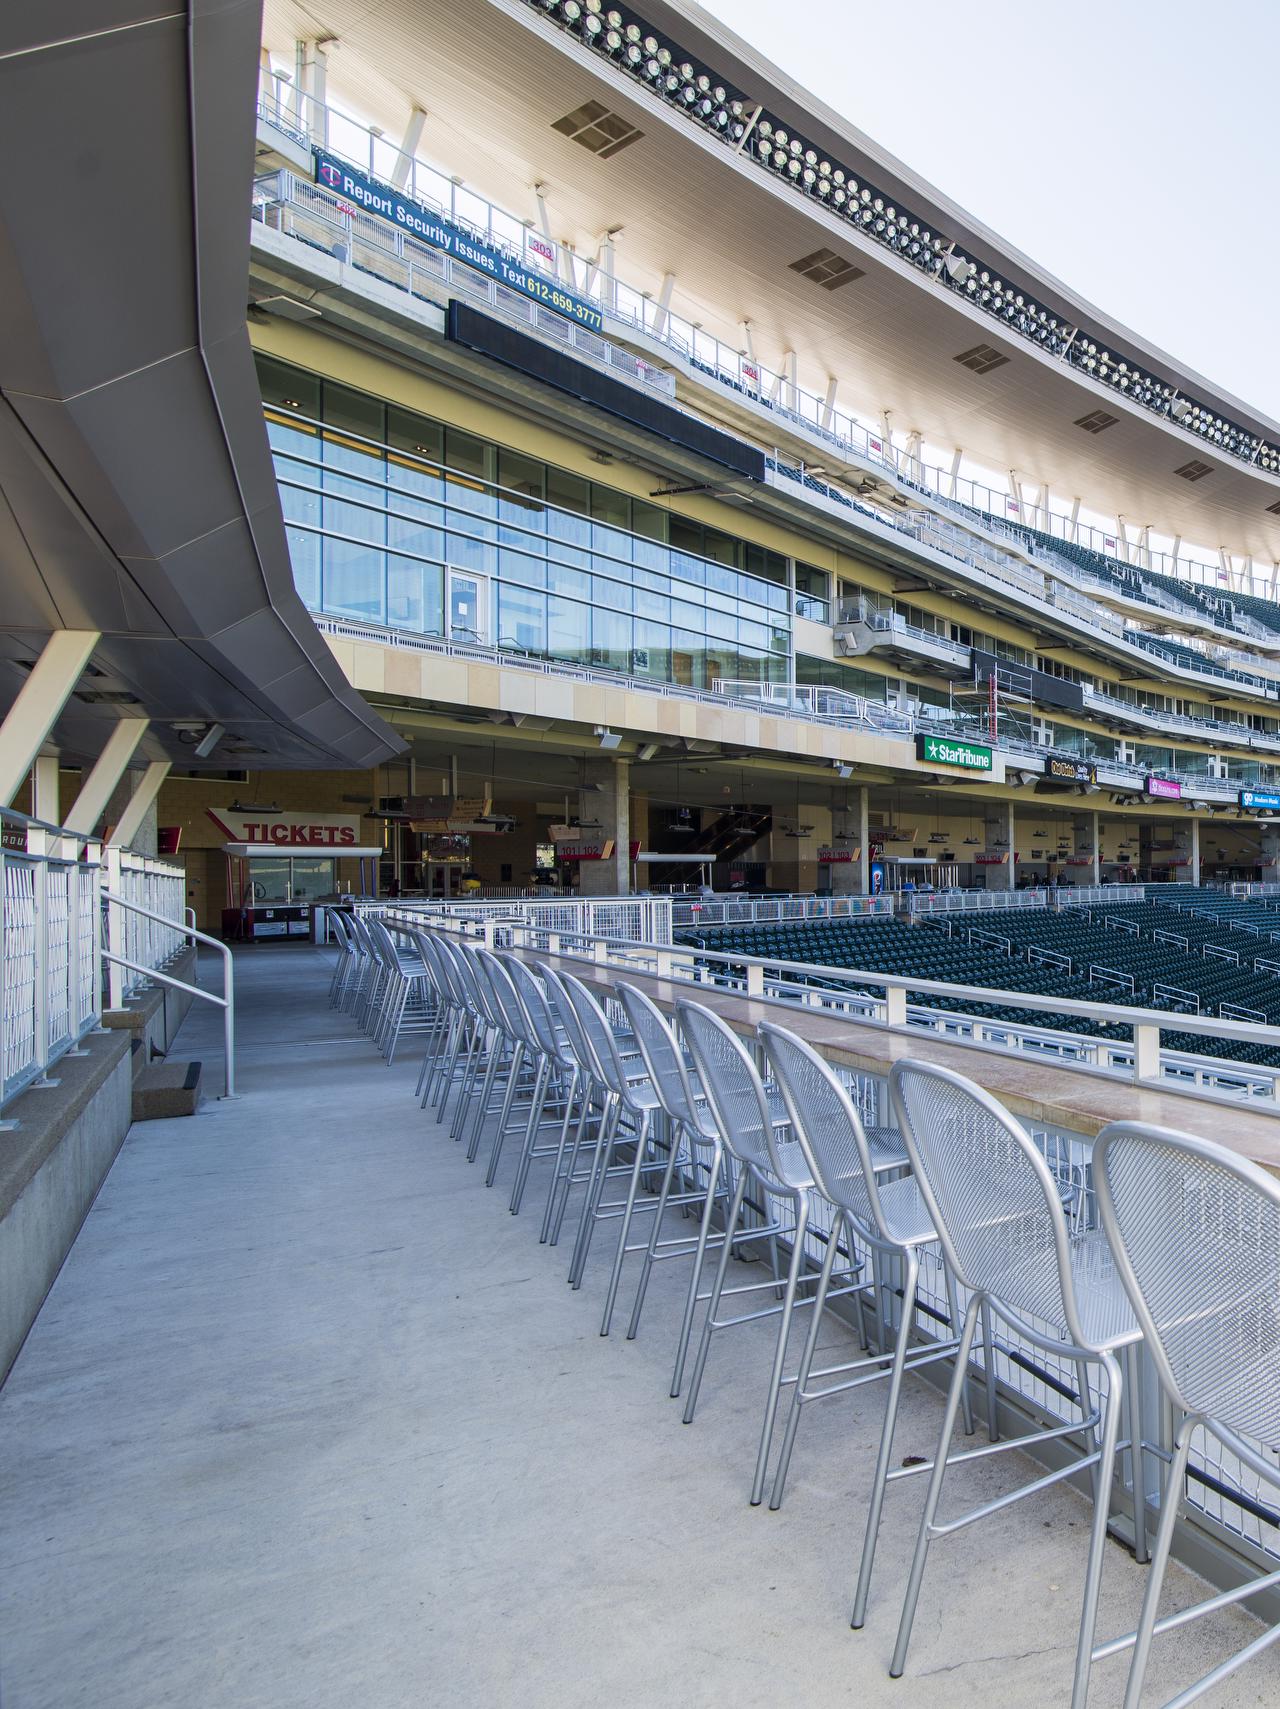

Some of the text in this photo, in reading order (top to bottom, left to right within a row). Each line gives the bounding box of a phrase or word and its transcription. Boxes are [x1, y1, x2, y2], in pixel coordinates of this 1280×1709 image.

[344, 176, 393, 216] Report
[396, 205, 452, 248] Security
[455, 238, 498, 273] Issues.
[501, 262, 527, 288] Text
[527, 278, 601, 327] 612-659-3777
[533, 240, 553, 258] 303
[939, 744, 989, 768] StarTribune
[243, 823, 355, 844] TICKETS
[562, 847, 599, 855] 101 102
